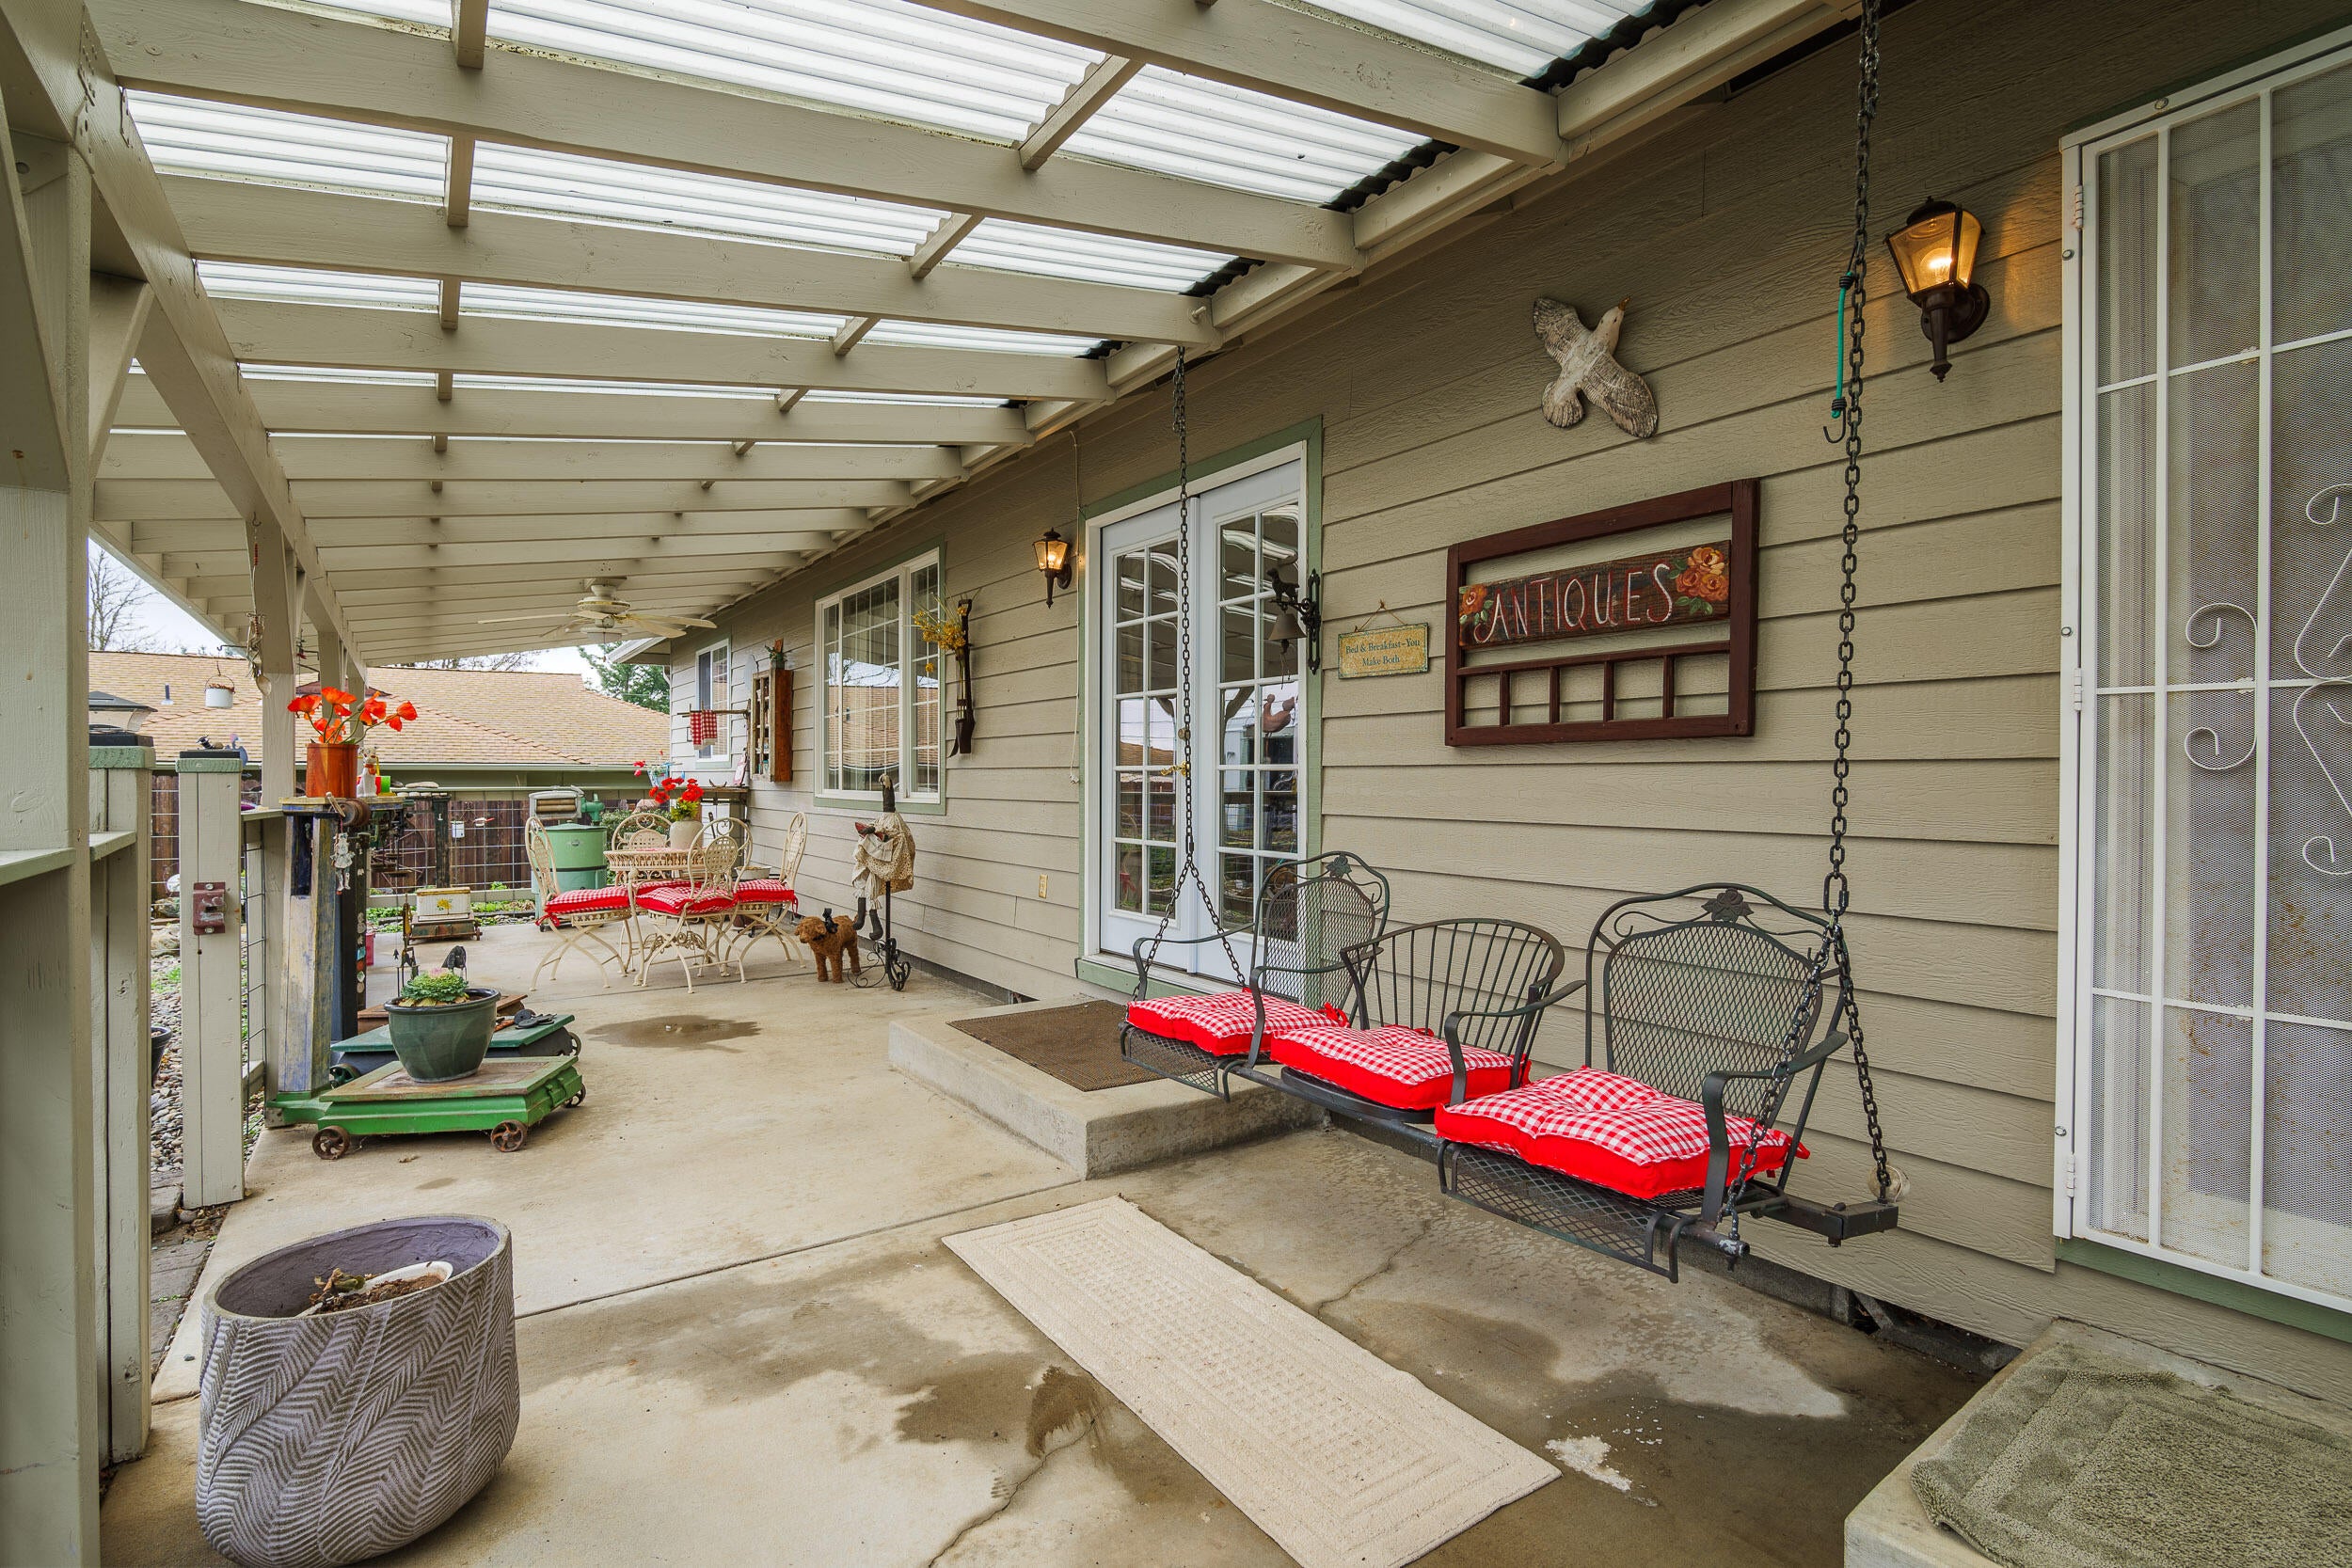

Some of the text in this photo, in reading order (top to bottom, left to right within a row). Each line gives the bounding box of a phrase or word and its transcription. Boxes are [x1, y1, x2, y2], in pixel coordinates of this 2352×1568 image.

[1473, 560, 1674, 643] ANTIQUES
[1345, 644, 1359, 655] Bed
[1360, 643, 1367, 653] &
[1362, 655, 1400, 667] Make Both
